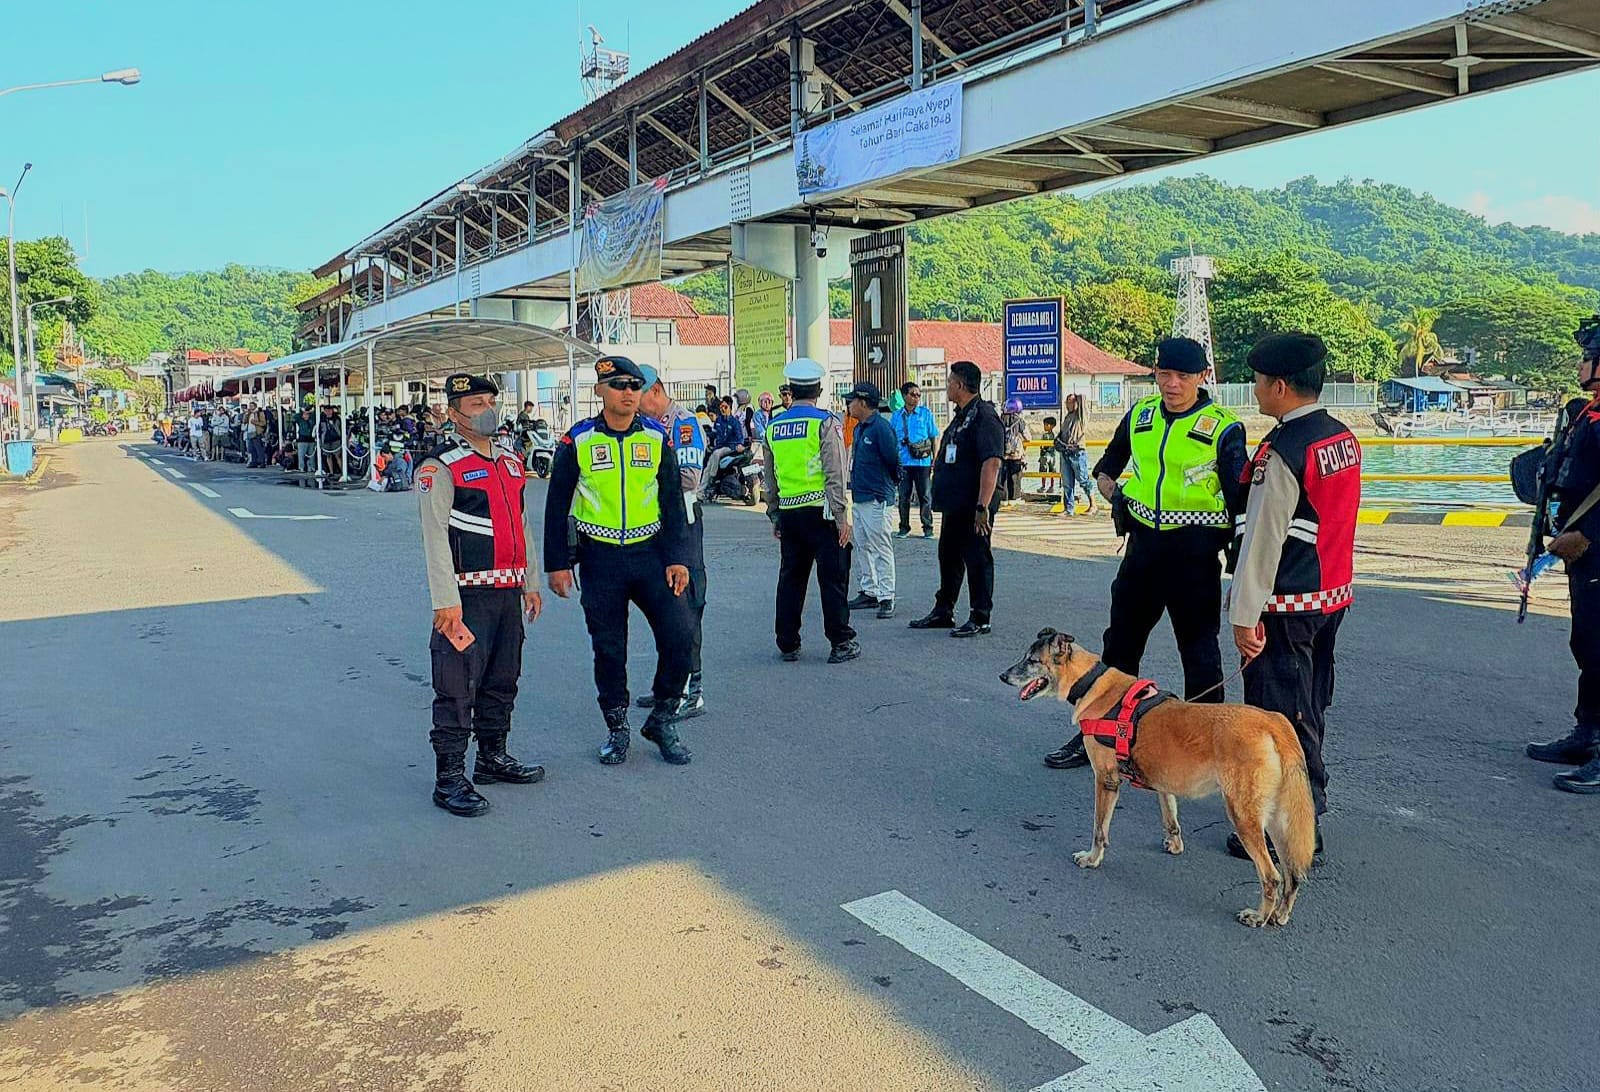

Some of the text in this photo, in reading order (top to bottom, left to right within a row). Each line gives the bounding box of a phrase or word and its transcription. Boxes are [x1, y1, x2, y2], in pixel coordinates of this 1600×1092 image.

[902, 106, 924, 119] Raya
[925, 95, 953, 114] Nyepi
[864, 277, 882, 329] 1
[1011, 312, 1040, 327] DERMAGA
[1010, 343, 1054, 356] MAX 30 TON
[1016, 377, 1040, 391] ZONA
[773, 422, 806, 438] POLISI
[1317, 438, 1360, 476] POLISI
